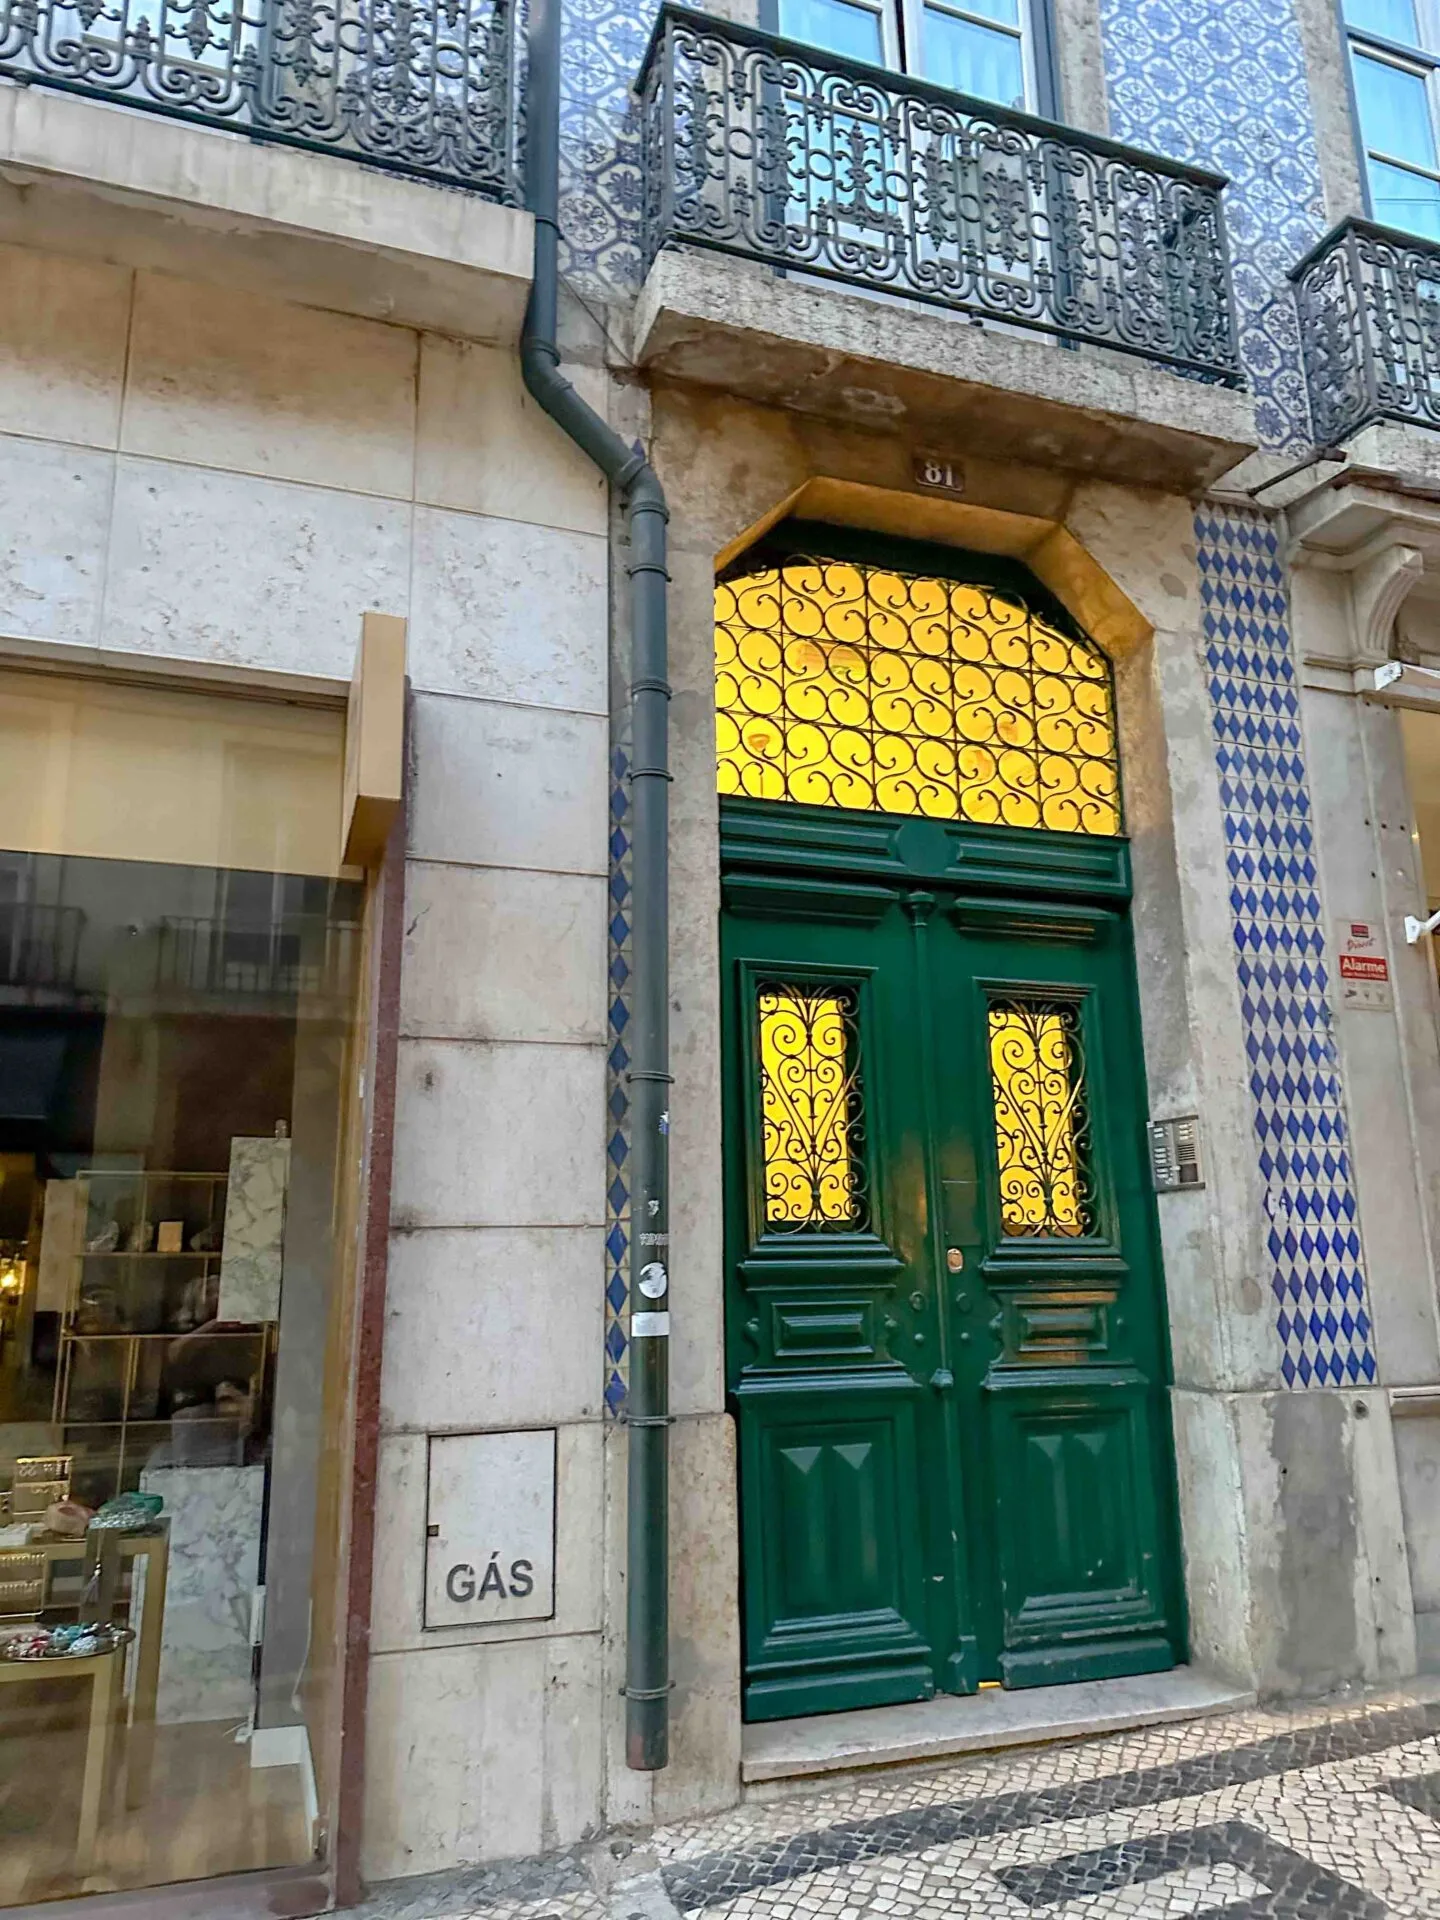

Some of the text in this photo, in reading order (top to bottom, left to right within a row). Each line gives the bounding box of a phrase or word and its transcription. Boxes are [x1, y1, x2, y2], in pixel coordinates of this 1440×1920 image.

[925, 459, 952, 486] 81
[1342, 957, 1386, 973] Alarme
[446, 1551, 534, 1603] GÁS
